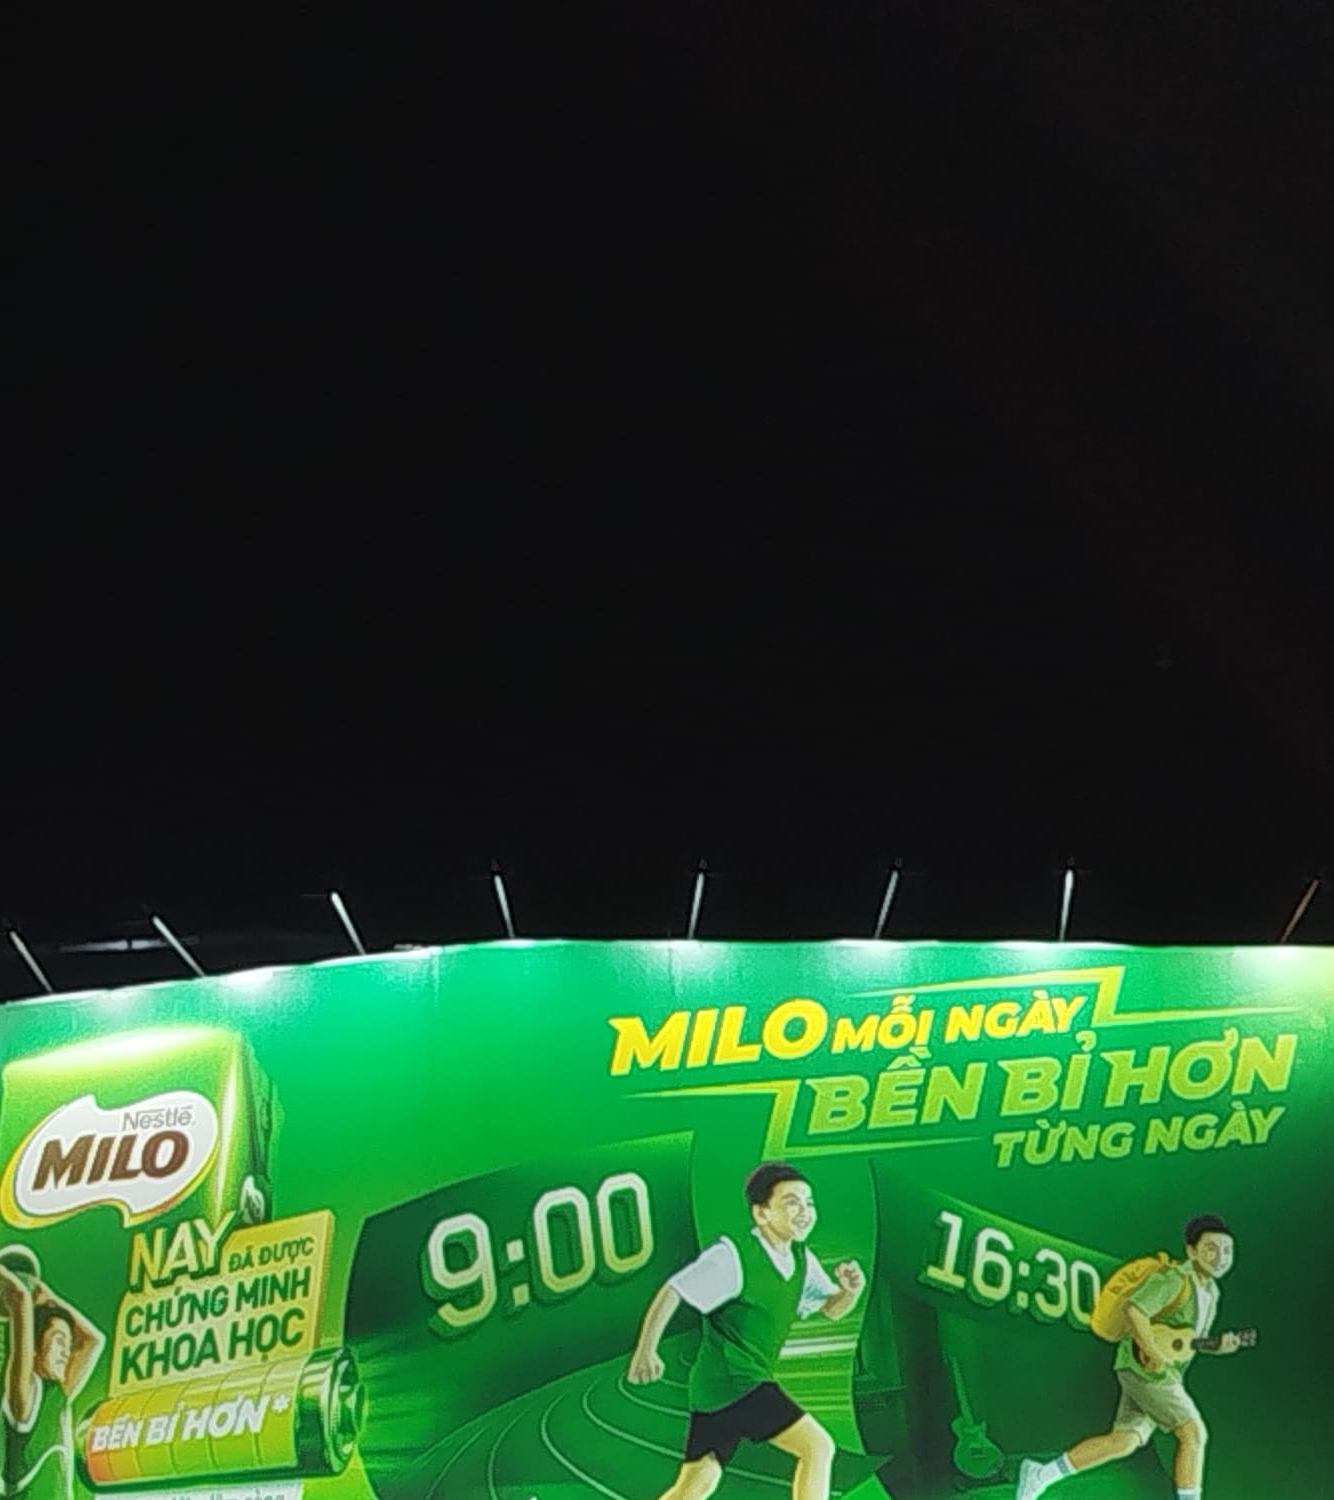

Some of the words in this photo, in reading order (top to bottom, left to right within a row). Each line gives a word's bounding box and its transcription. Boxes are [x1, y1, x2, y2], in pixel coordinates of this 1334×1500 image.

[610, 1000, 828, 1076] MILO
[833, 993, 931, 1053] MỖI
[946, 996, 1087, 1045] NGÀY
[122, 1105, 194, 1132] Nestlé
[797, 1048, 987, 1135] BỀN
[1000, 1033, 1095, 1117] BỈ
[1105, 1028, 1297, 1105] HƠN
[32, 1130, 190, 1194] MILO
[993, 1115, 1133, 1168] TỪNG
[1143, 1105, 1286, 1155] NGÀY
[129, 1210, 236, 1292] NAY
[228, 1243, 255, 1272] ĐÃ
[259, 1236, 315, 1265] ĐƯỢC
[427, 1172, 654, 1328] 9:00
[926, 1211, 1101, 1325] 16:30
[125, 1285, 229, 1337] CHỨNG
[235, 1266, 311, 1313] MINH
[119, 1328, 221, 1384] KHOA
[228, 1308, 305, 1362] HỌC
